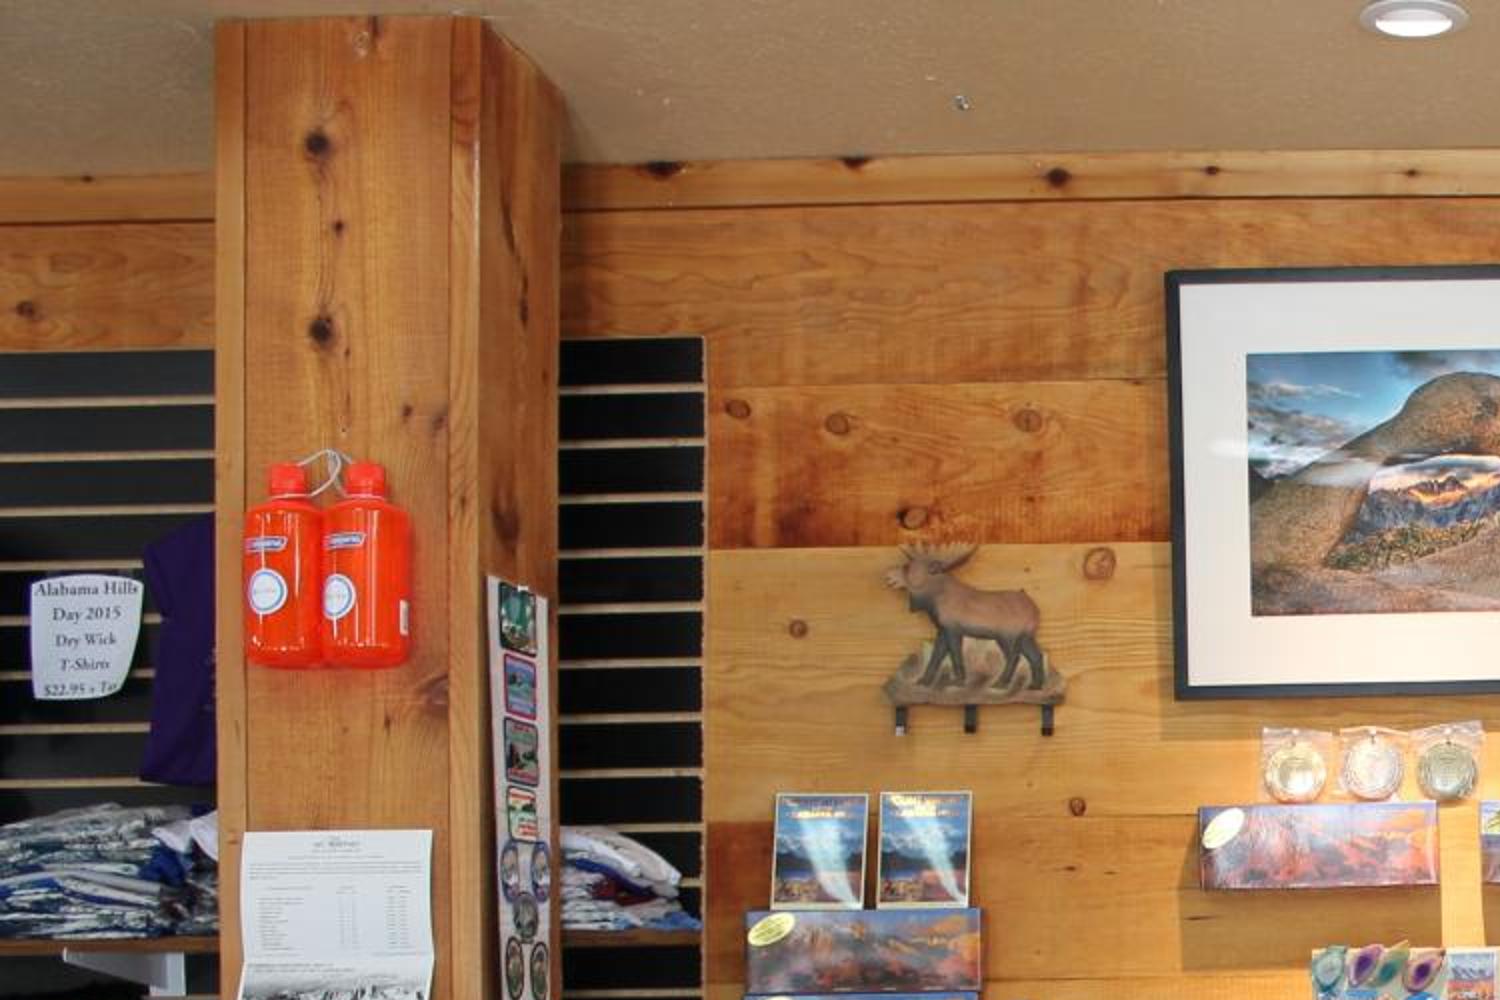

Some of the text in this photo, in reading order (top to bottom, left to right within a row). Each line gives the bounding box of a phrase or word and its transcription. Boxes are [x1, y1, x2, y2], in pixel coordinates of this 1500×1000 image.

[36, 580, 138, 596] Alabama Hills
[52, 606, 122, 624] Day 2015
[55, 632, 117, 649] Dry Wick
